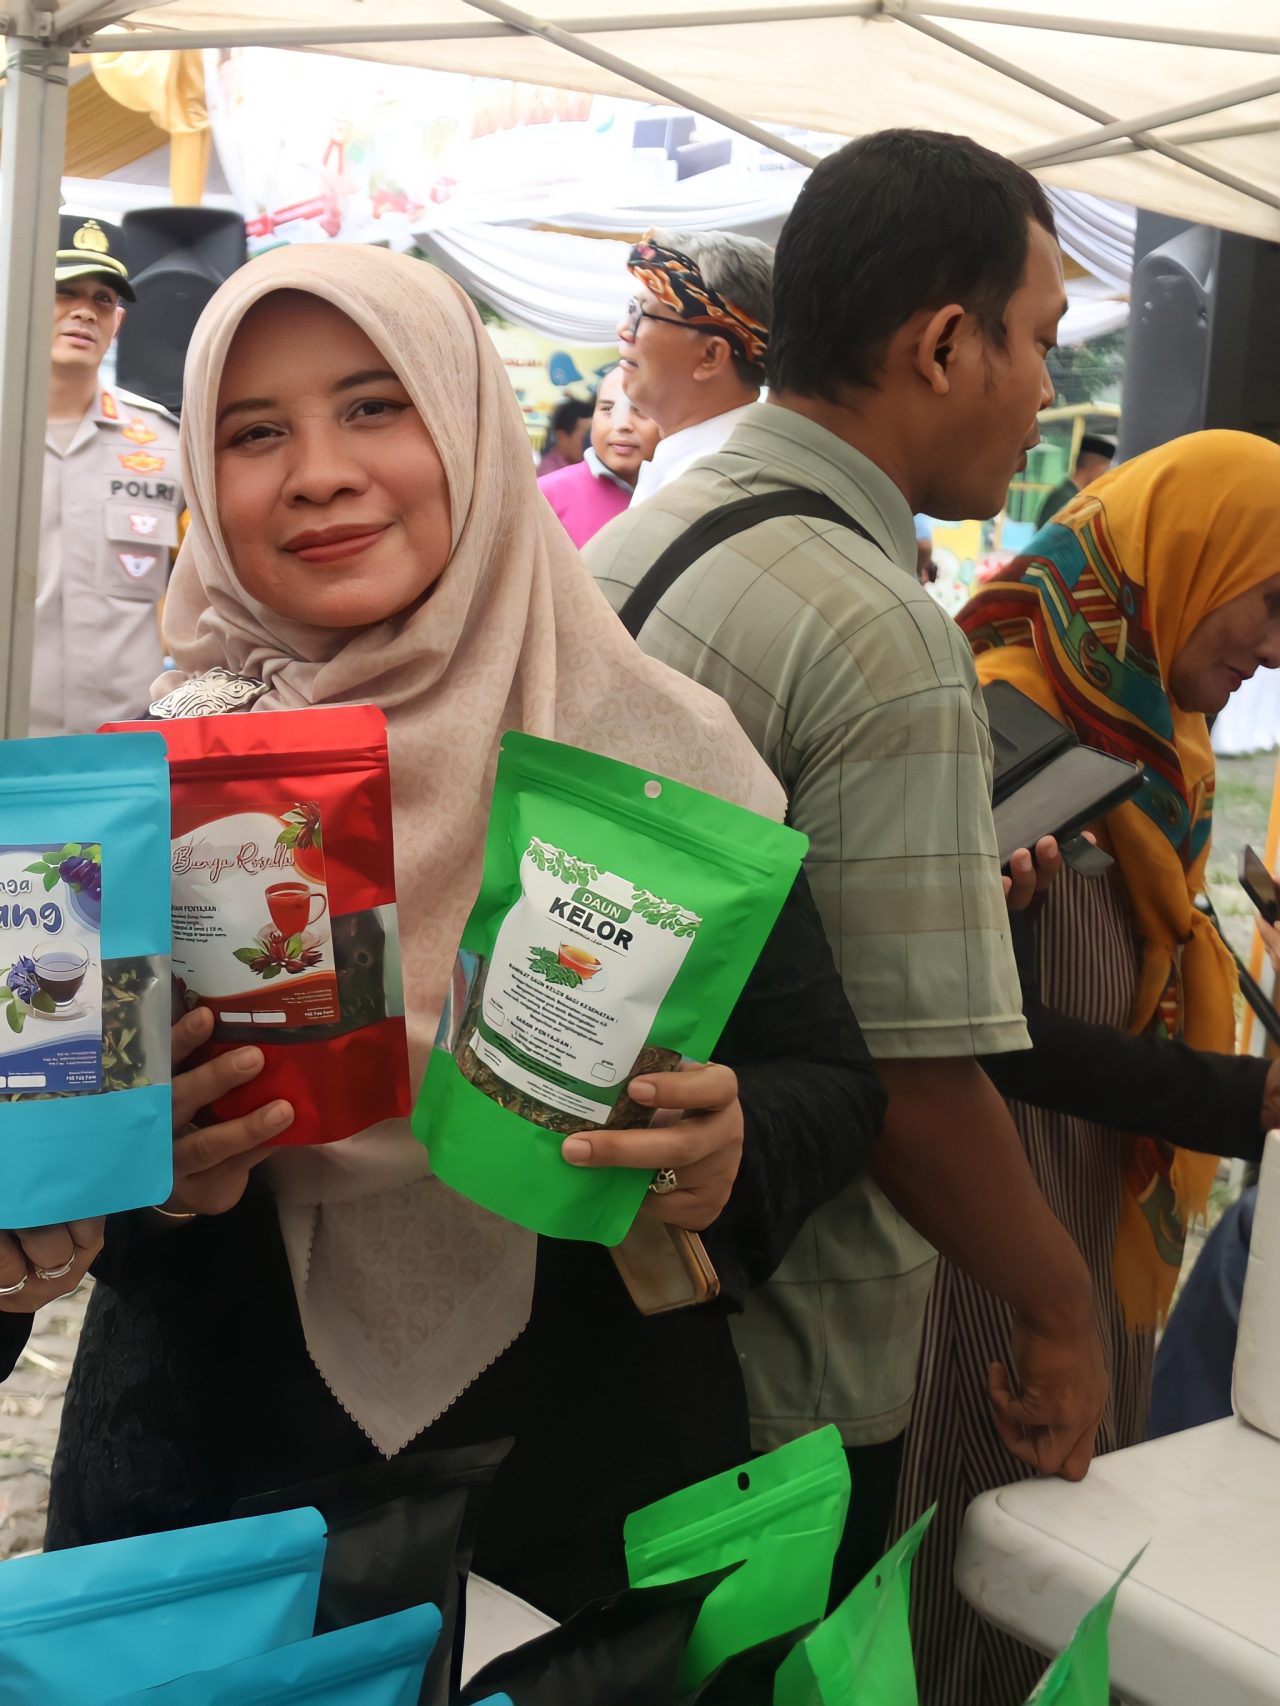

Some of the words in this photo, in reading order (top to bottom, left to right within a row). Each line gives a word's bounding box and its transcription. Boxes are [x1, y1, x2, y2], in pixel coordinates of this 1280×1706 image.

[110, 479, 176, 500] POLRI
[172, 845, 234, 883] Bunga
[581, 893, 622, 919] DAUN
[548, 896, 634, 951] KELOR
